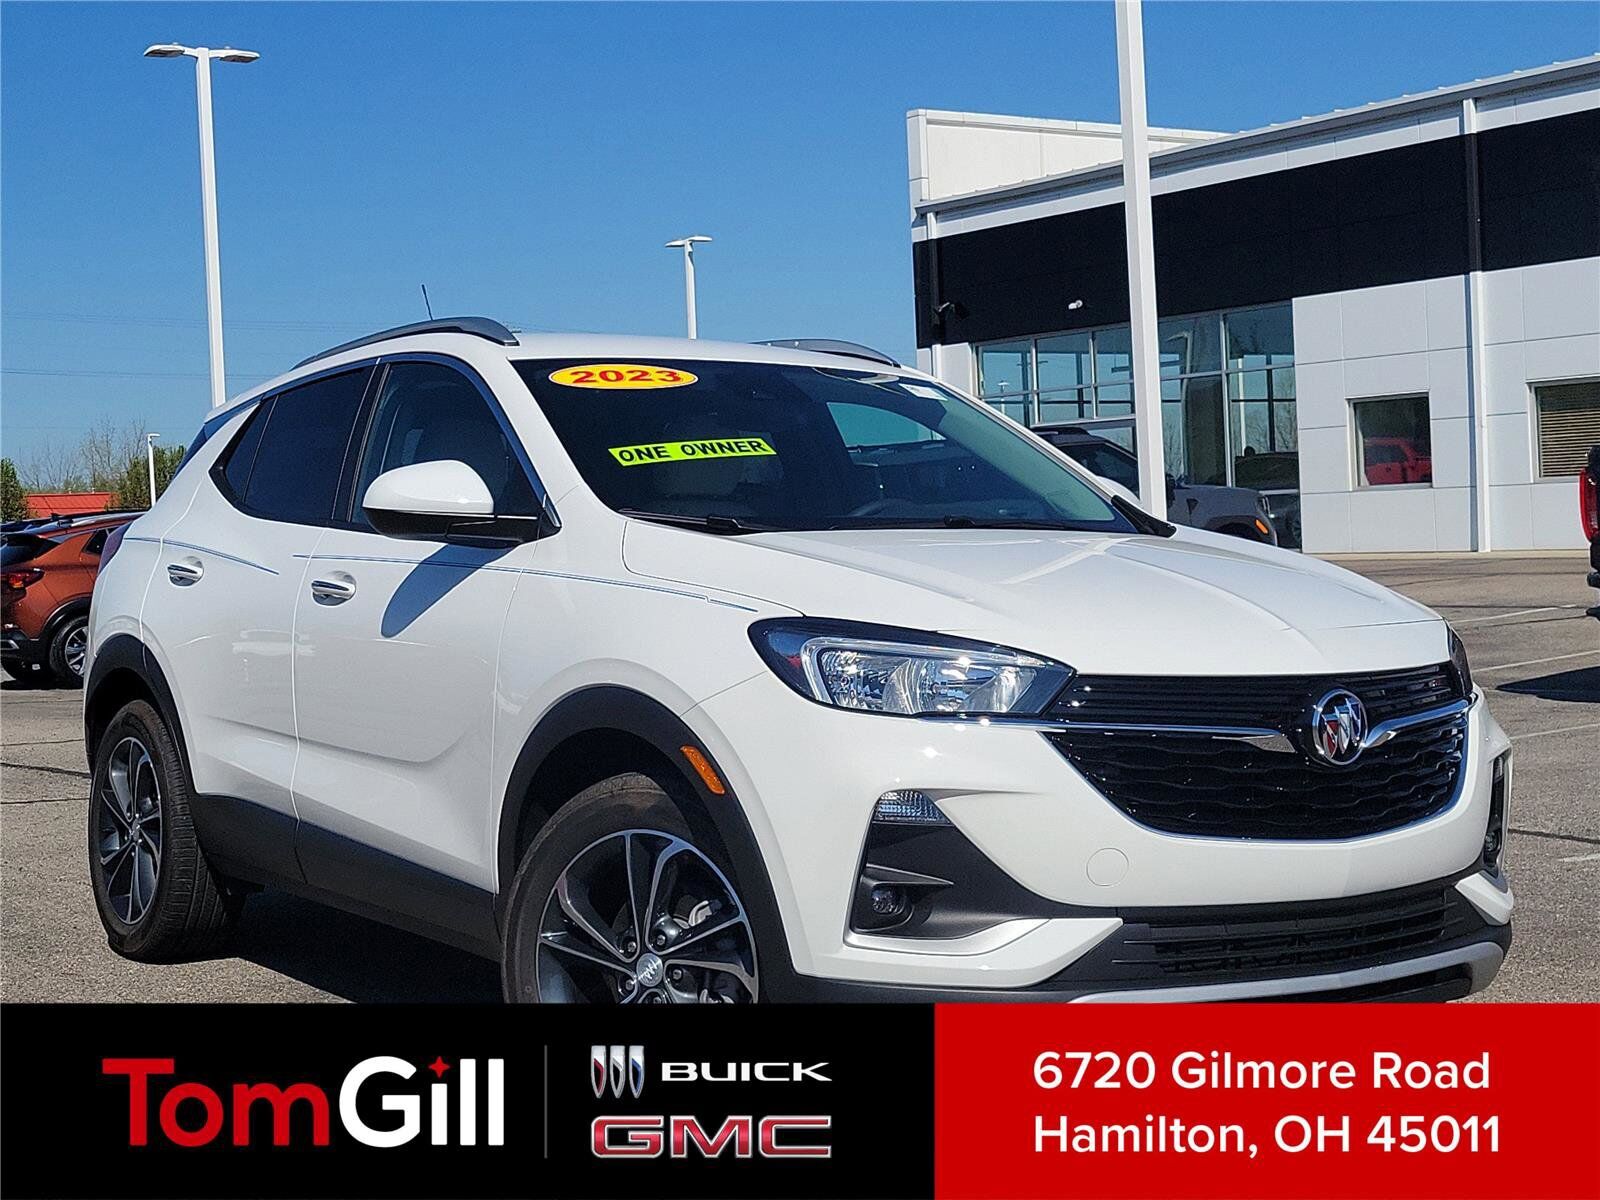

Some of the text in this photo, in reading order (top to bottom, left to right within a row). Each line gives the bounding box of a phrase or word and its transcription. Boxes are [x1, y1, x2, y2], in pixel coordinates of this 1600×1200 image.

[570, 370, 682, 384] 2023
[618, 440, 768, 462] ONE OWNER
